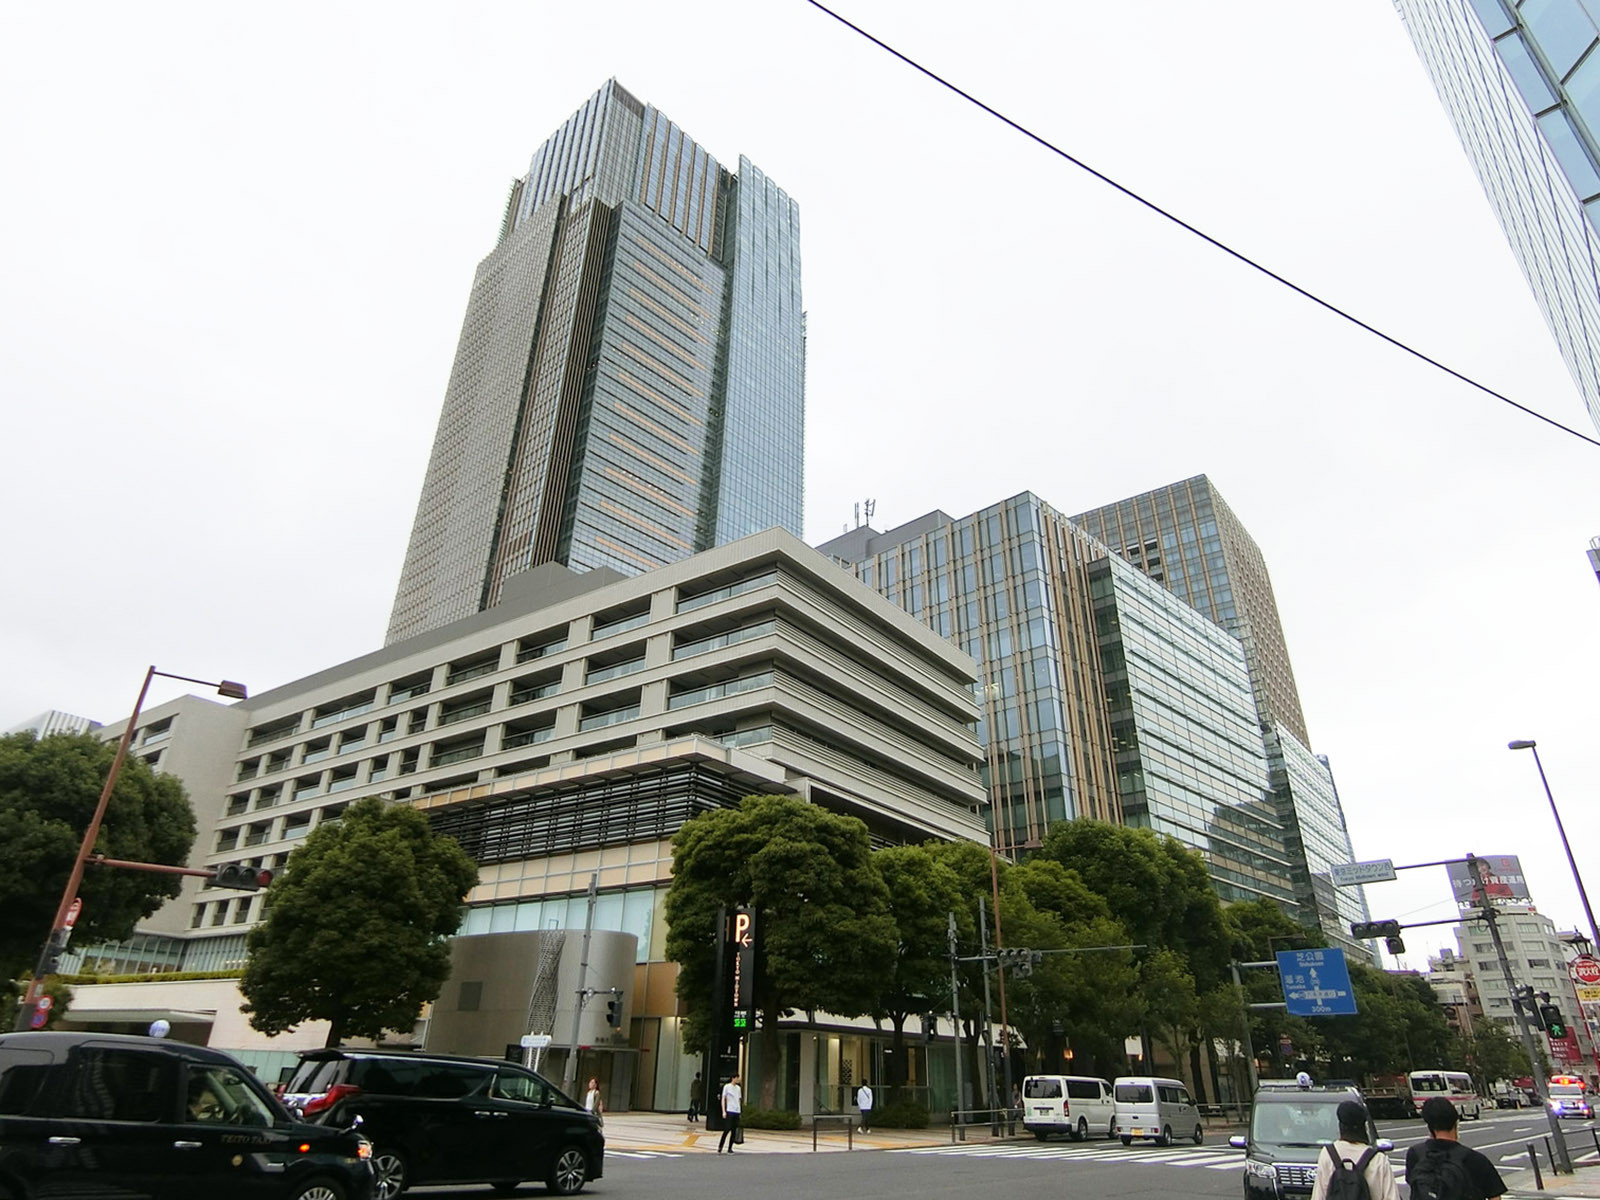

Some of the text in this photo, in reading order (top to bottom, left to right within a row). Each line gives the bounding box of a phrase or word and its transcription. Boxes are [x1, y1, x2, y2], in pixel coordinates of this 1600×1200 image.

[1453, 875, 1526, 888] 待つけ資産運用
[735, 913, 750, 943] P
[1296, 951, 1324, 962] 芝公園
